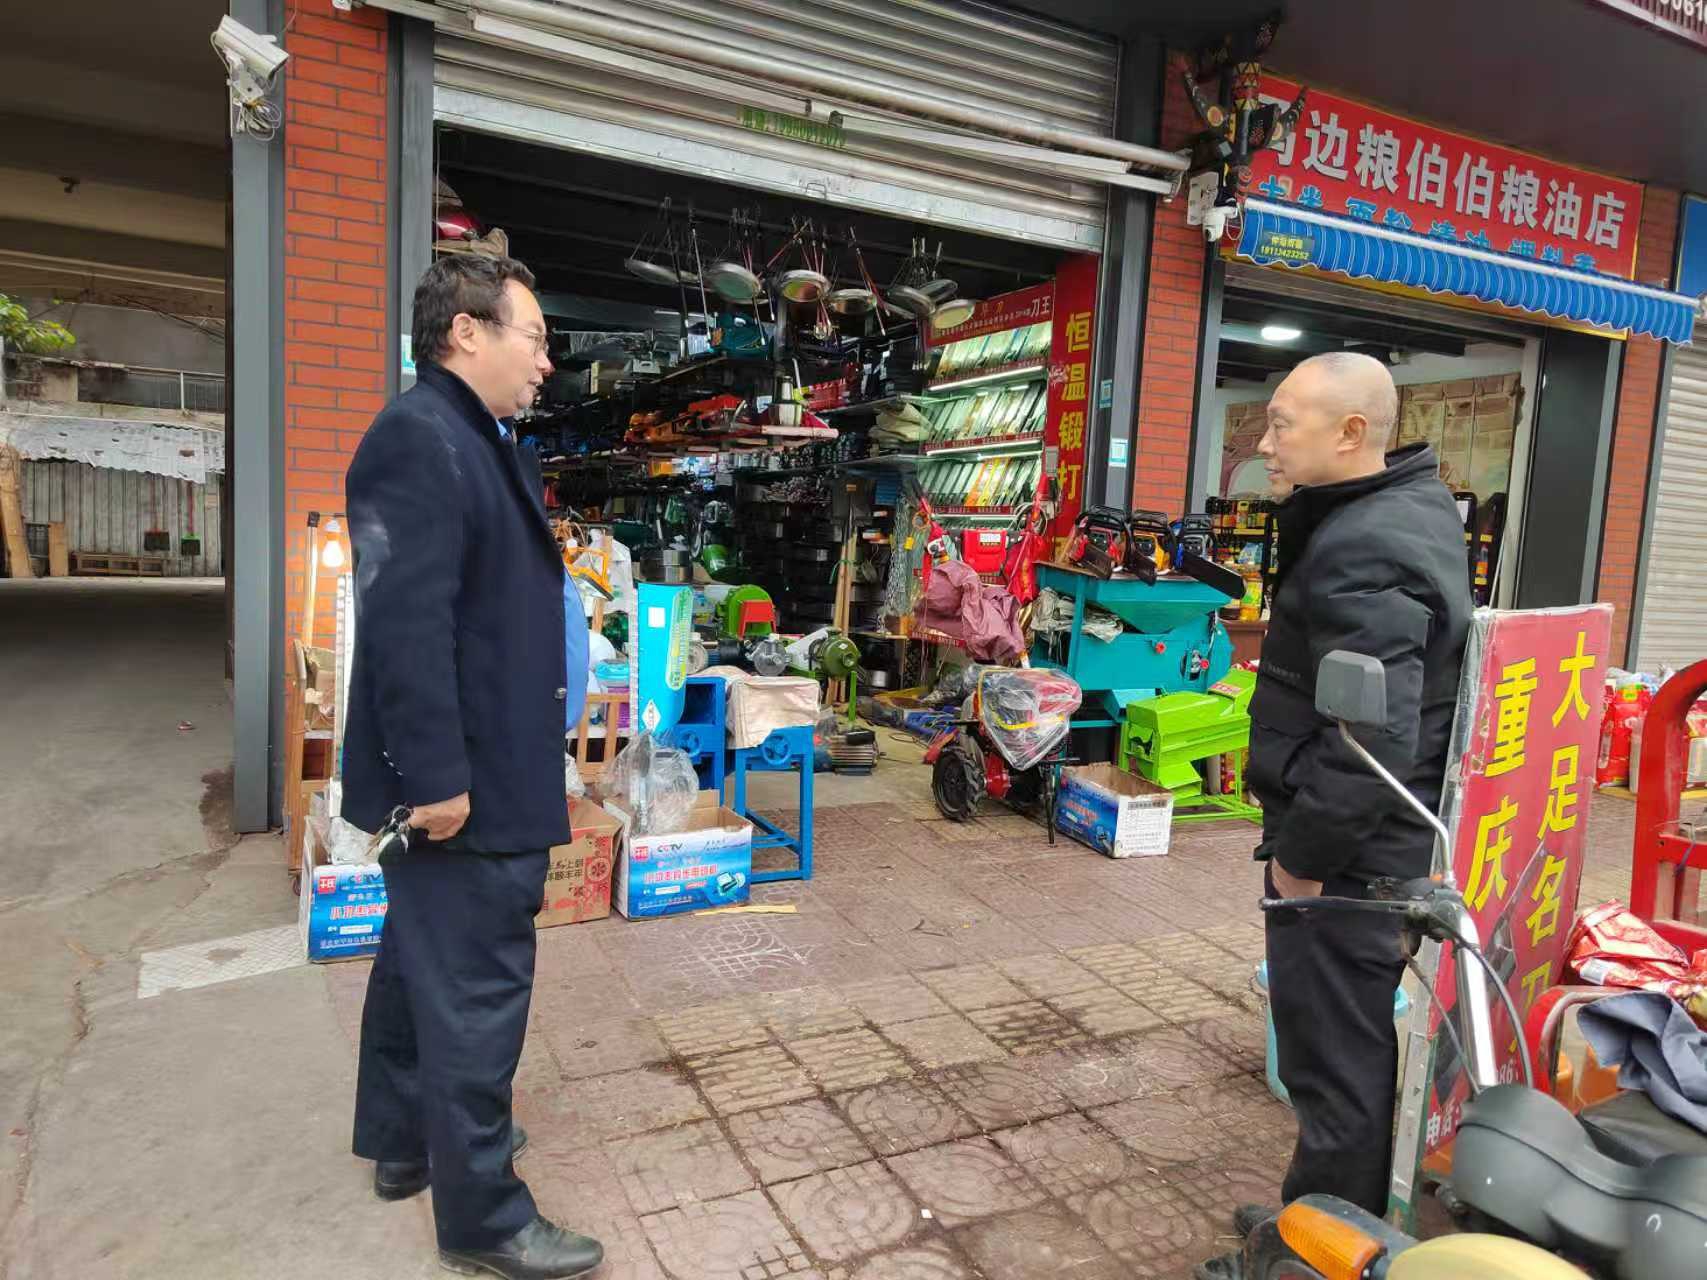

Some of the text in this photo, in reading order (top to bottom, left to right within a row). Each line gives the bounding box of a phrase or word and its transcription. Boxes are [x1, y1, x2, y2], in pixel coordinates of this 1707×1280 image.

[1057, 311, 1091, 501] 恒温锻打
[1462, 657, 1538, 913] 重庆
